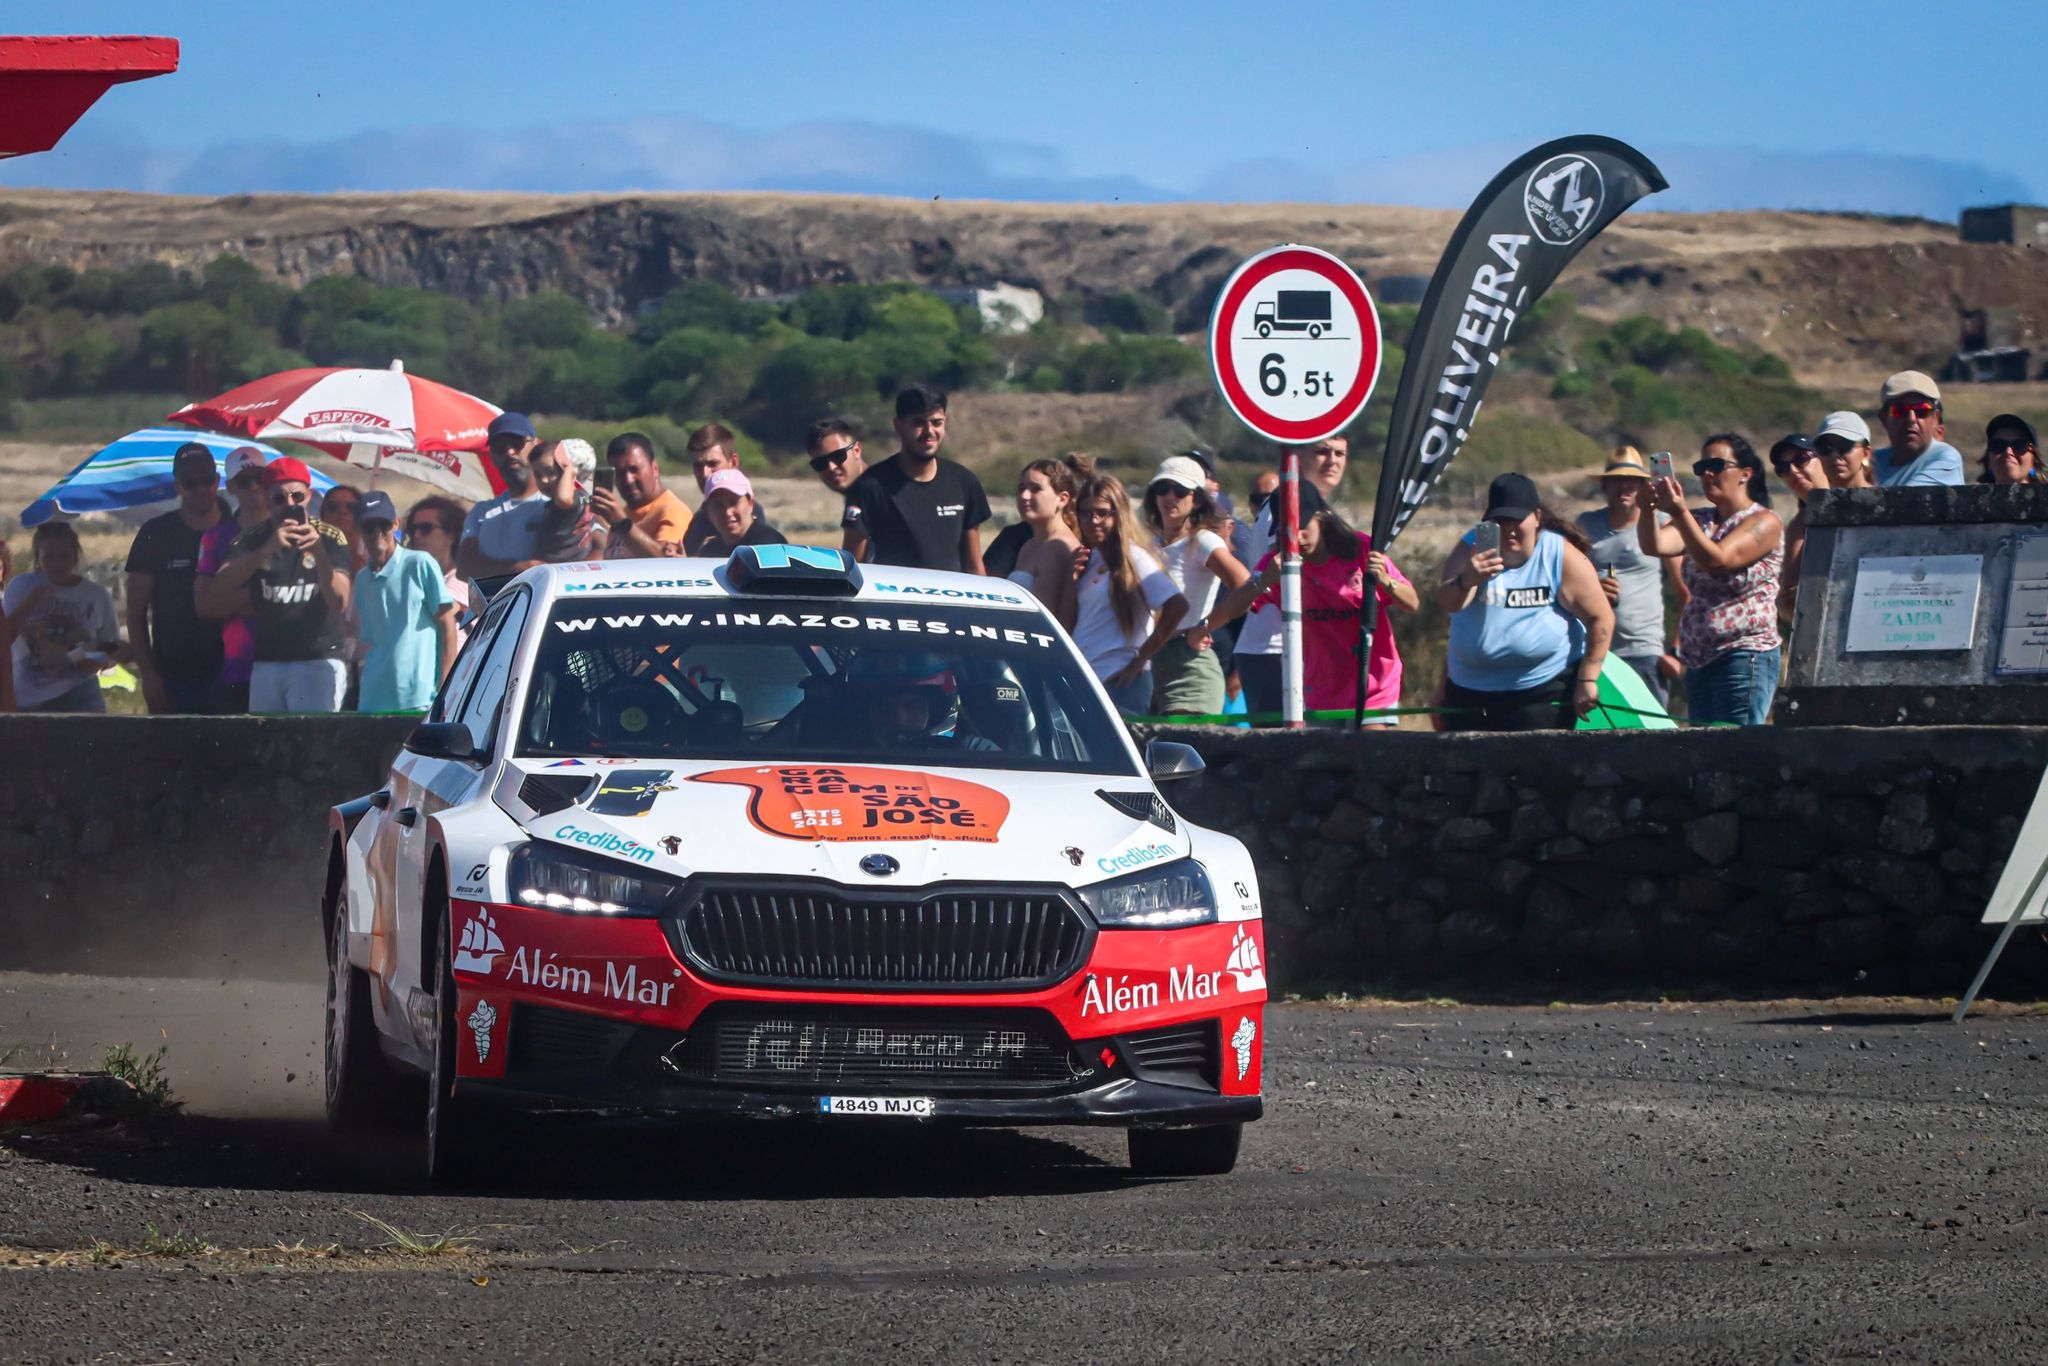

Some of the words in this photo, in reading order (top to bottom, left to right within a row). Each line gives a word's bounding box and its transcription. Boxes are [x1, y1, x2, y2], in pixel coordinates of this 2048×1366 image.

[1420, 233, 1531, 464] OLIVEIRA
[554, 612, 1055, 648] WWW.INAZORES.NET
[1881, 611, 1944, 626] ZAMBA
[997, 689, 1019, 699] OMP
[862, 793, 960, 810] SÃO
[794, 817, 843, 829] 2015
[863, 808, 976, 828] JOSÉ
[555, 825, 655, 862] Credibom
[1097, 842, 1177, 874] Credibom
[506, 946, 592, 994] Além
[604, 961, 676, 1007] Mar
[1081, 974, 1158, 1017] Além
[1169, 963, 1222, 1004] Mar
[834, 1099, 879, 1113] 4849
[884, 1099, 927, 1114] MJC
